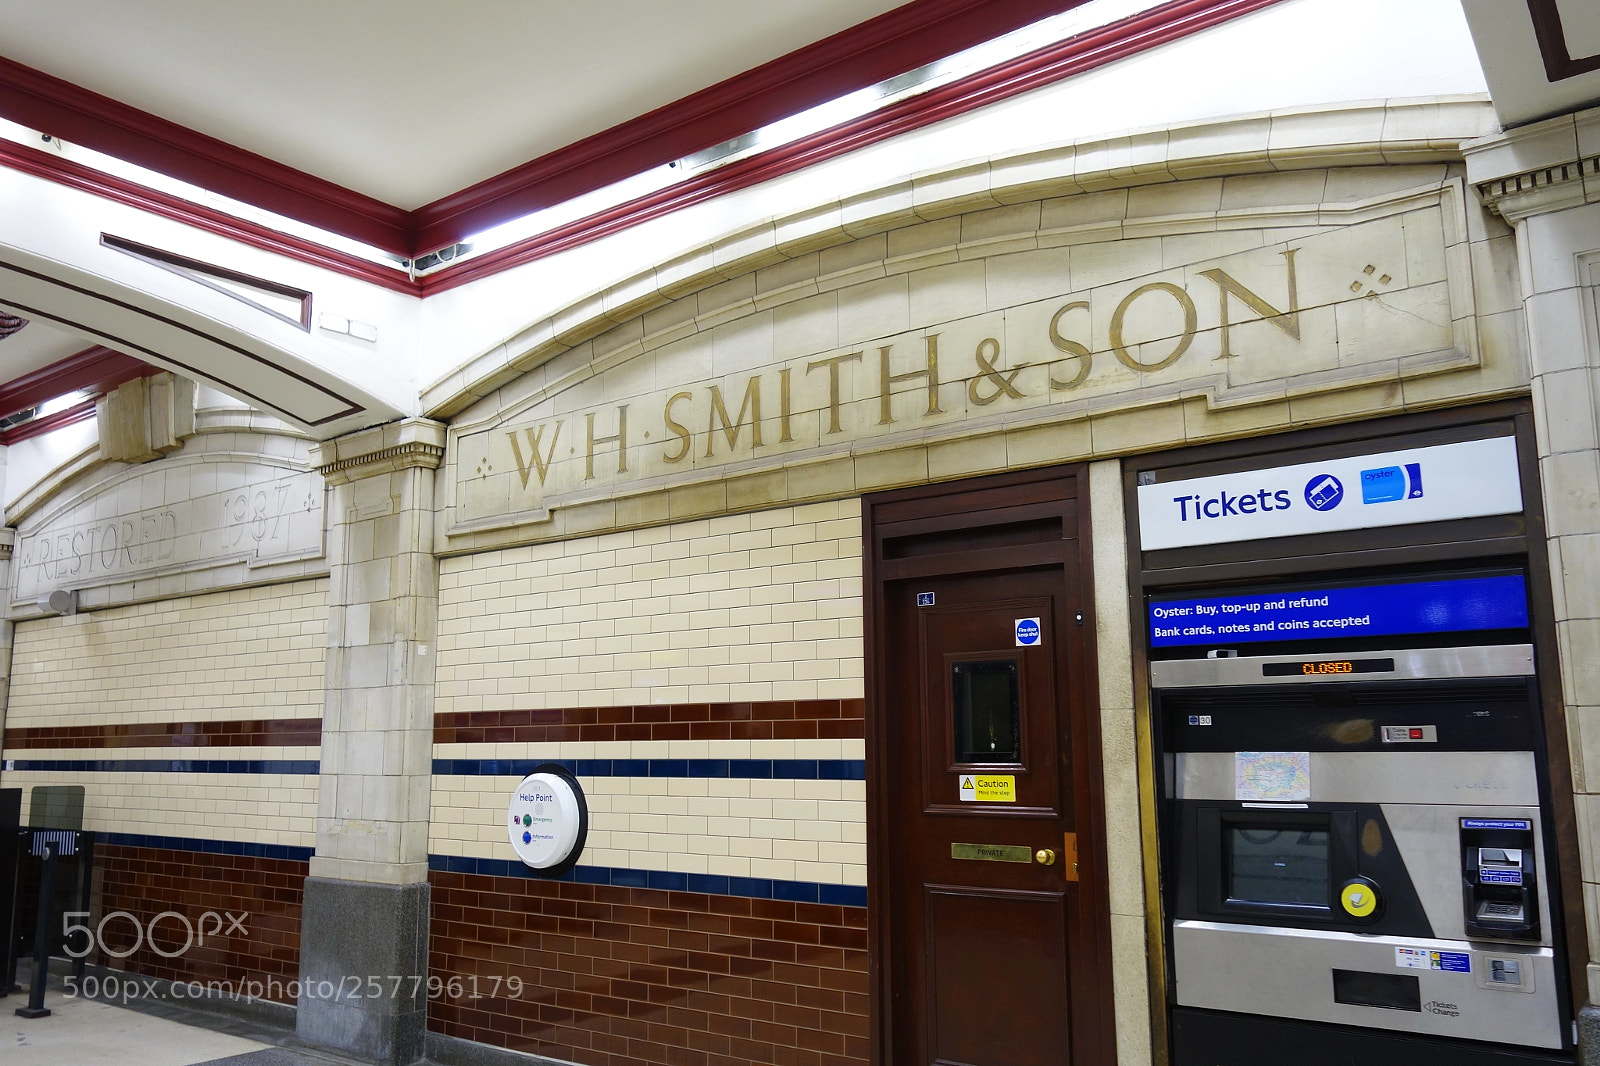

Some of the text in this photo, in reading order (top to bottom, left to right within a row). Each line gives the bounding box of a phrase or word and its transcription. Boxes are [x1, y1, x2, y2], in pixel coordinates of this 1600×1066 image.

[969, 337, 1031, 406] &
[1047, 247, 1302, 390] SON
[1364, 469, 1396, 481] oyster
[1173, 488, 1292, 522] Tickets
[36, 483, 292, 583] RESTORED 1987
[1153, 596, 1329, 619] Oyster: Buy, top-up and refund
[1154, 615, 1370, 638] Bank cards, notes and coins accepted
[1302, 662, 1353, 675] CLOSED
[1200, 716, 1211, 725] 30
[977, 779, 1009, 788] Caution
[519, 793, 553, 803] Help Point
[977, 848, 1004, 857] PRIVATE
[1431, 1000, 1458, 1010] Tickets
[1432, 1008, 1460, 1017] Change
